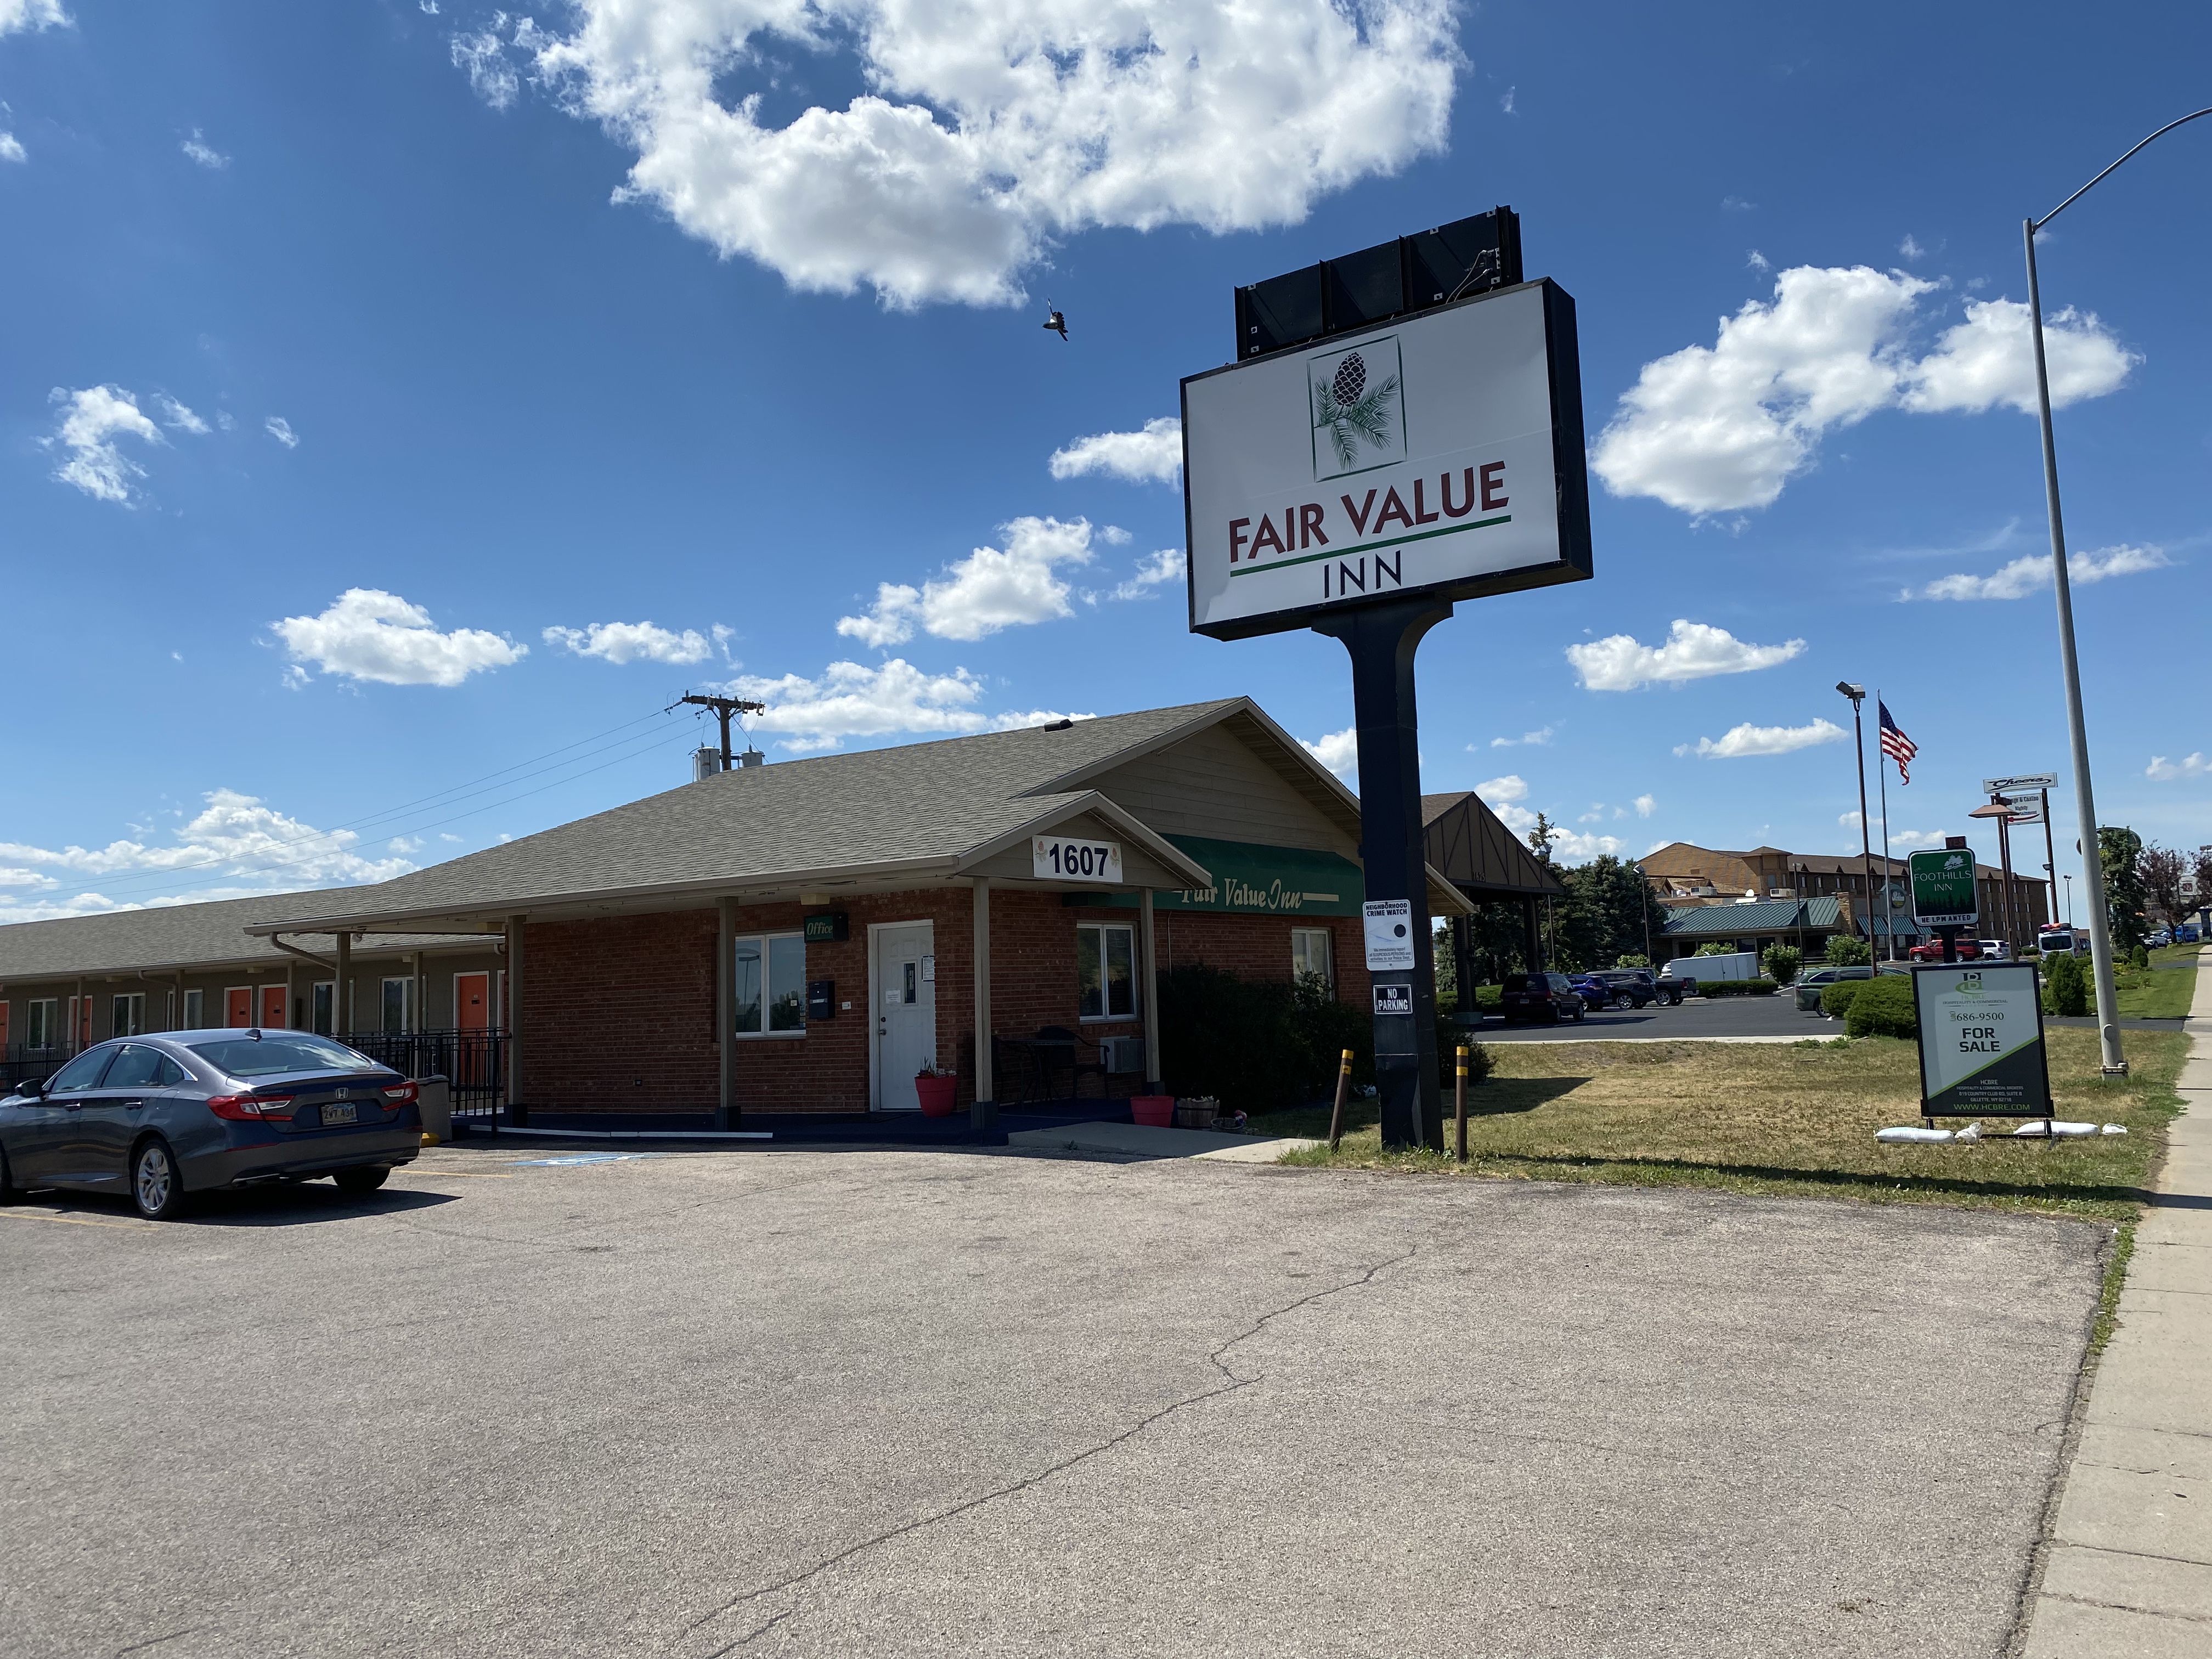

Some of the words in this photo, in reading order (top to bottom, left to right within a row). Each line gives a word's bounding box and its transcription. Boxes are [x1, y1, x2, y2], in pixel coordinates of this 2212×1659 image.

[1229, 503, 1329, 563] FAIR
[1340, 460, 1510, 538] VALUE
[1324, 550, 1402, 599] INN
[1987, 777, 2052, 792] Cheers
[1049, 843, 1109, 877] 1607
[1914, 870, 1972, 882] FOOTHILLS
[1934, 883, 1953, 891] INN
[1224, 878, 1267, 908] Value
[1267, 878, 1302, 910] Inn
[1365, 902, 1408, 911] NEIGHBORHOOD
[806, 922, 833, 935] Office
[1387, 988, 1397, 999] NO
[1378, 999, 1408, 1011] PARKING
[1956, 1012, 2004, 1022] 686-9500
[1962, 1027, 1996, 1039] FOR
[1959, 1041, 2001, 1052] SALE
